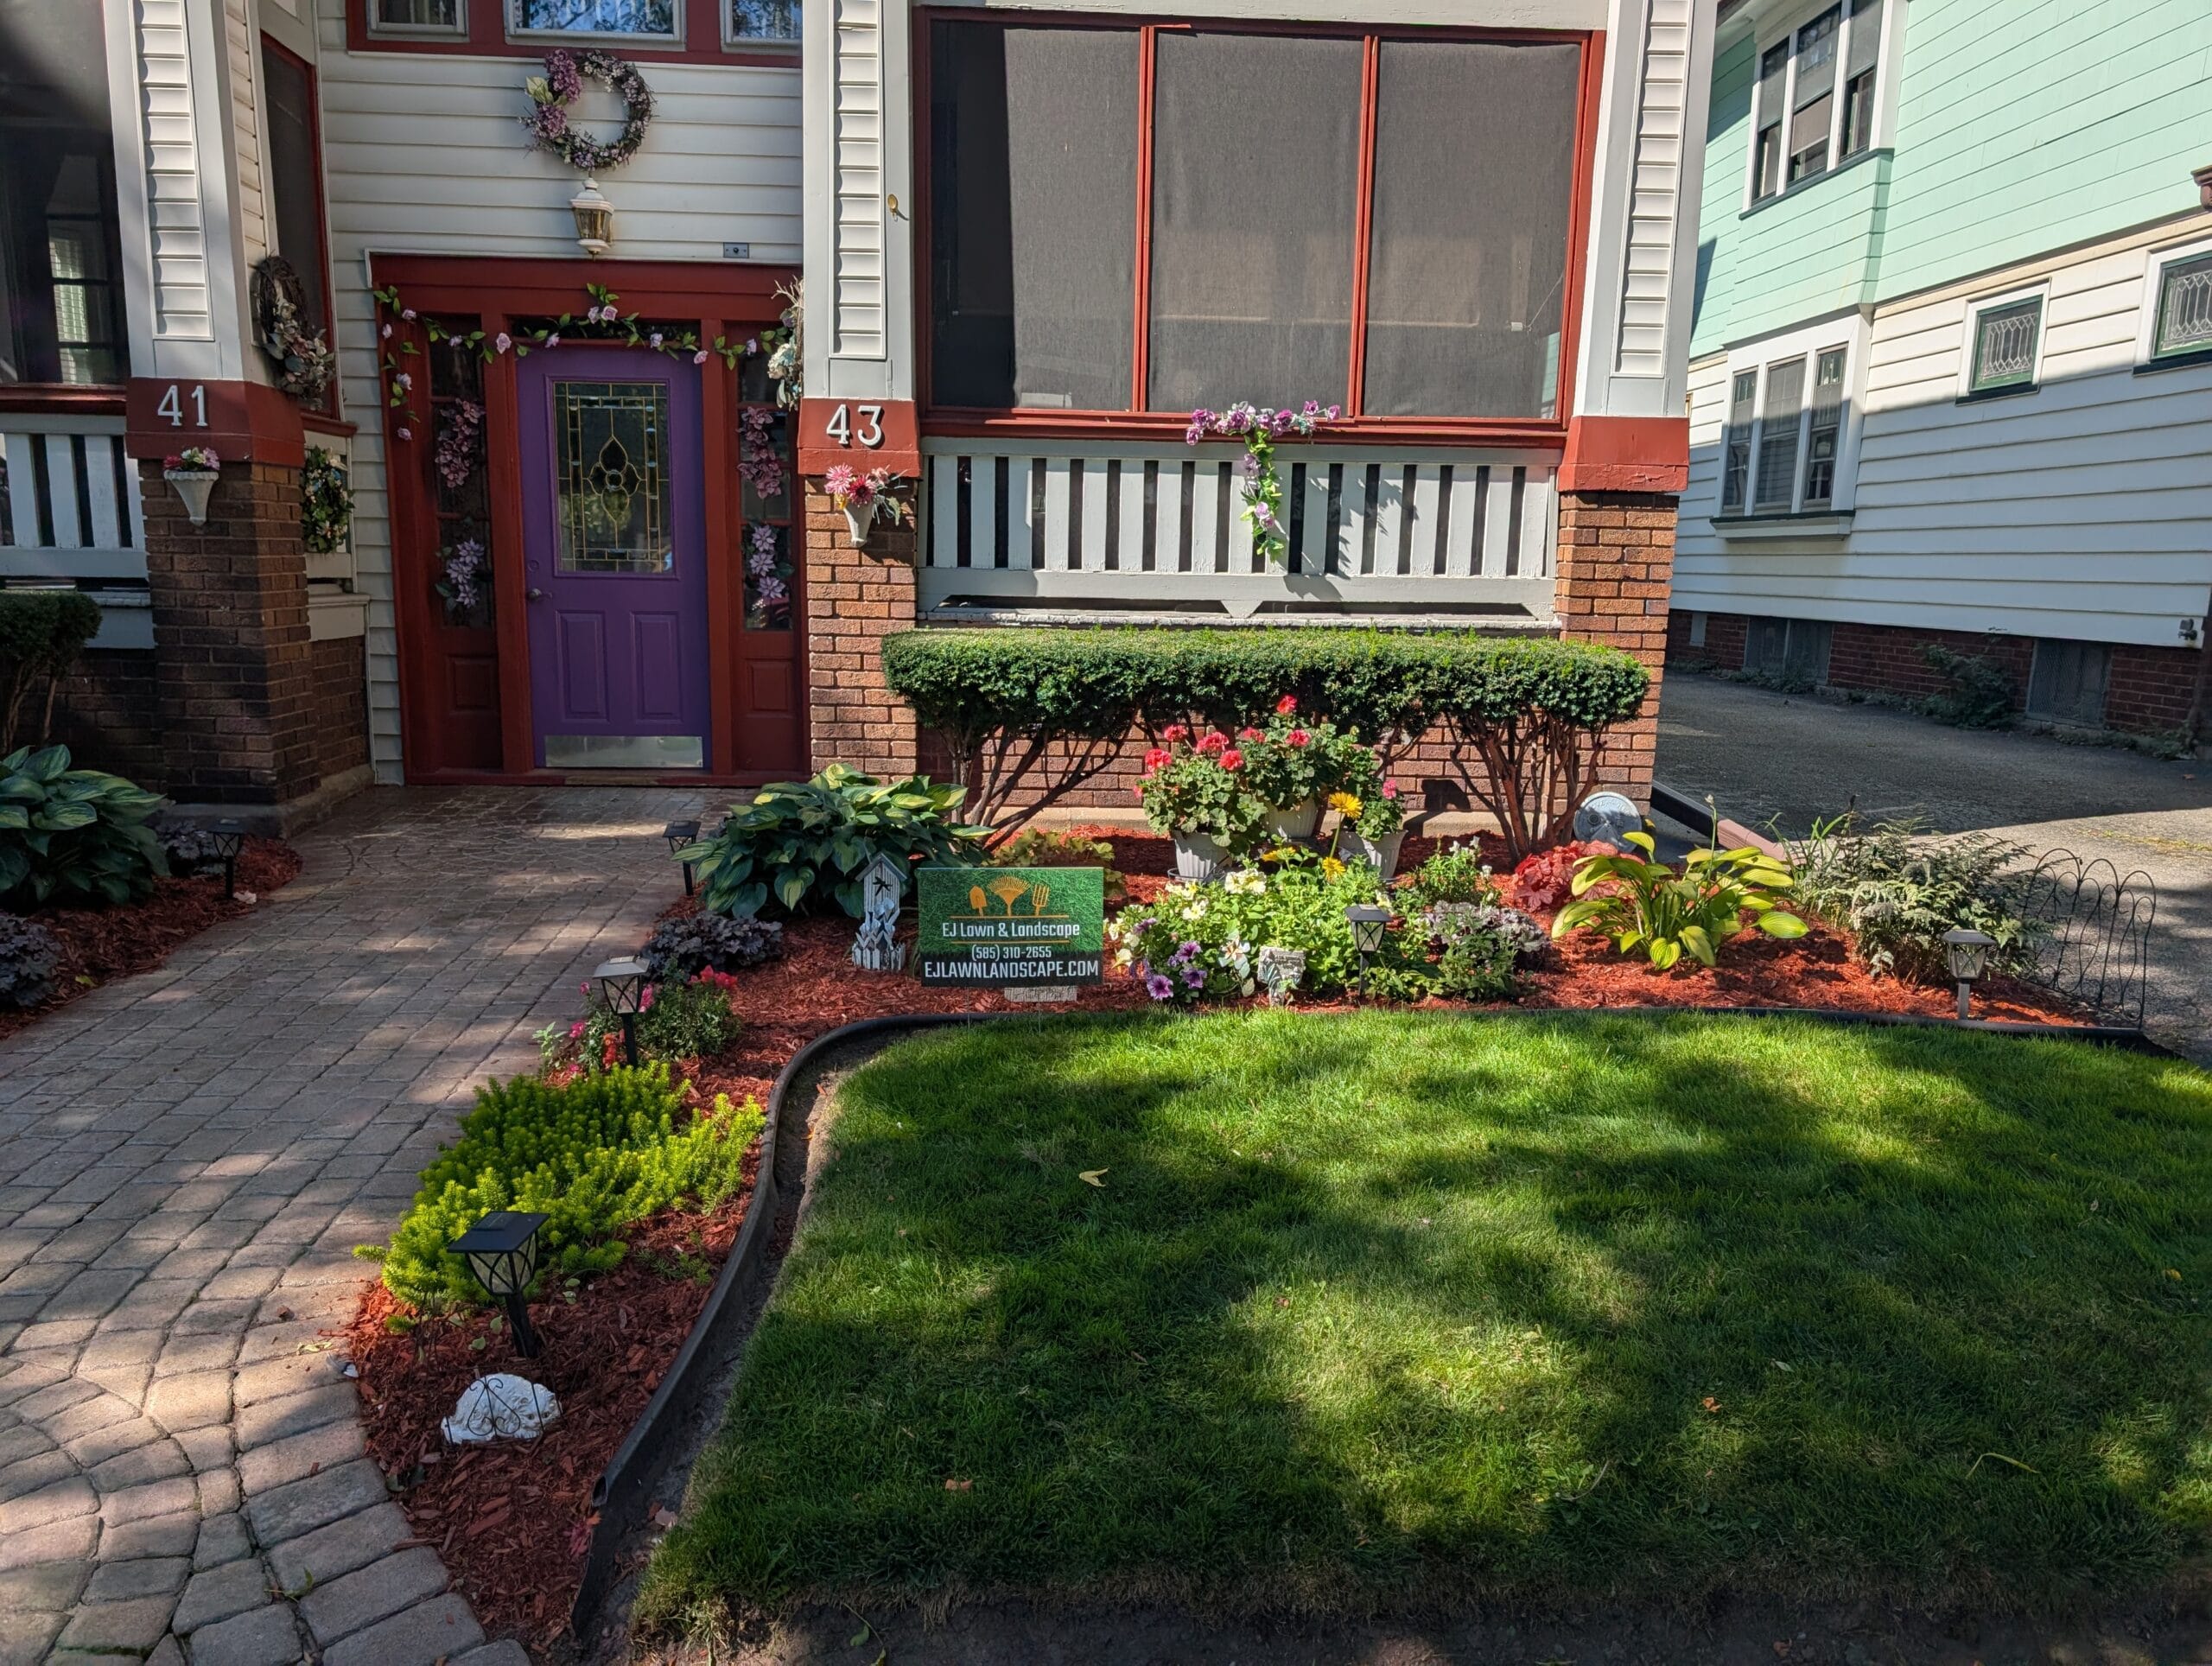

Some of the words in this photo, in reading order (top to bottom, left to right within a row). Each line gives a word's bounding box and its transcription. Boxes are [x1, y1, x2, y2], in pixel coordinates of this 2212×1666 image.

[157, 385, 207, 427] 41
[826, 404, 881, 446] 43
[942, 922, 957, 937] EJ
[960, 922, 994, 937] Lawn
[998, 922, 1009, 938] &
[1011, 922, 1080, 938] Landscape
[971, 944, 1000, 962] (585)
[1003, 946, 1052, 959] 310-2655
[925, 960, 1098, 978] EJLAWNLANDSCAPE.COM
